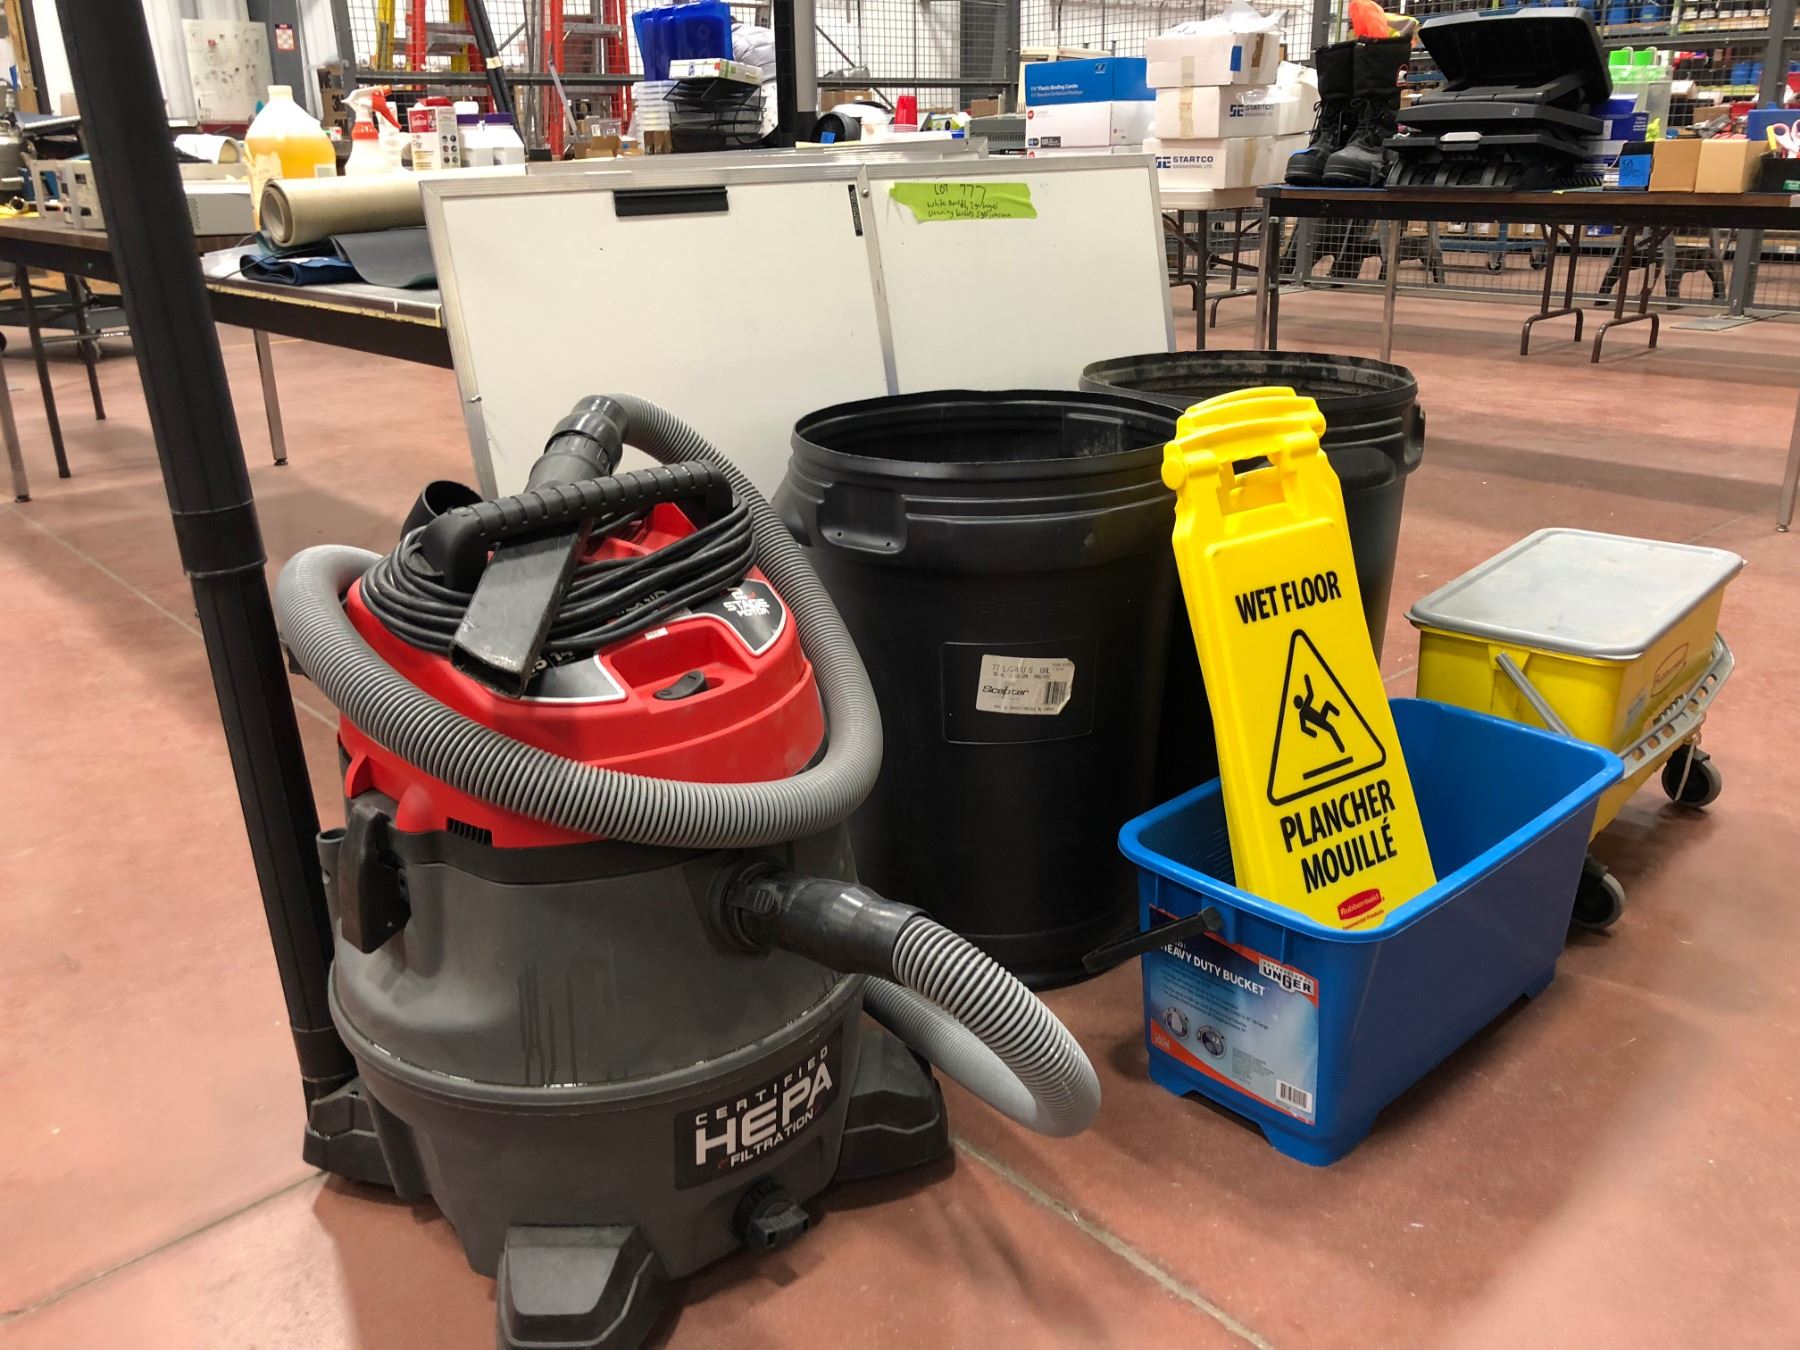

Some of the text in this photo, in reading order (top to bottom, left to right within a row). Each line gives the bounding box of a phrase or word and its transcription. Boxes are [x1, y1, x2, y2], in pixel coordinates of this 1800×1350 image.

[934, 183, 987, 207] LOT 777
[723, 598, 769, 611] STAGE
[736, 607, 770, 617] MOTOR
[1235, 570, 1342, 624] WET FLOOR
[982, 685, 1030, 696] Scepter
[1280, 779, 1396, 853] PLANCHER
[1301, 816, 1397, 894] MOUILLÉ
[1340, 892, 1379, 917] Rubbermaid
[1193, 955, 1221, 977] DUTY
[1223, 969, 1266, 997] BUCKET
[1263, 966, 1312, 993] UNGER
[695, 1045, 828, 1126] CERTIFIED
[695, 1062, 832, 1166] HEPA
[730, 1107, 814, 1168] FILTRATION
